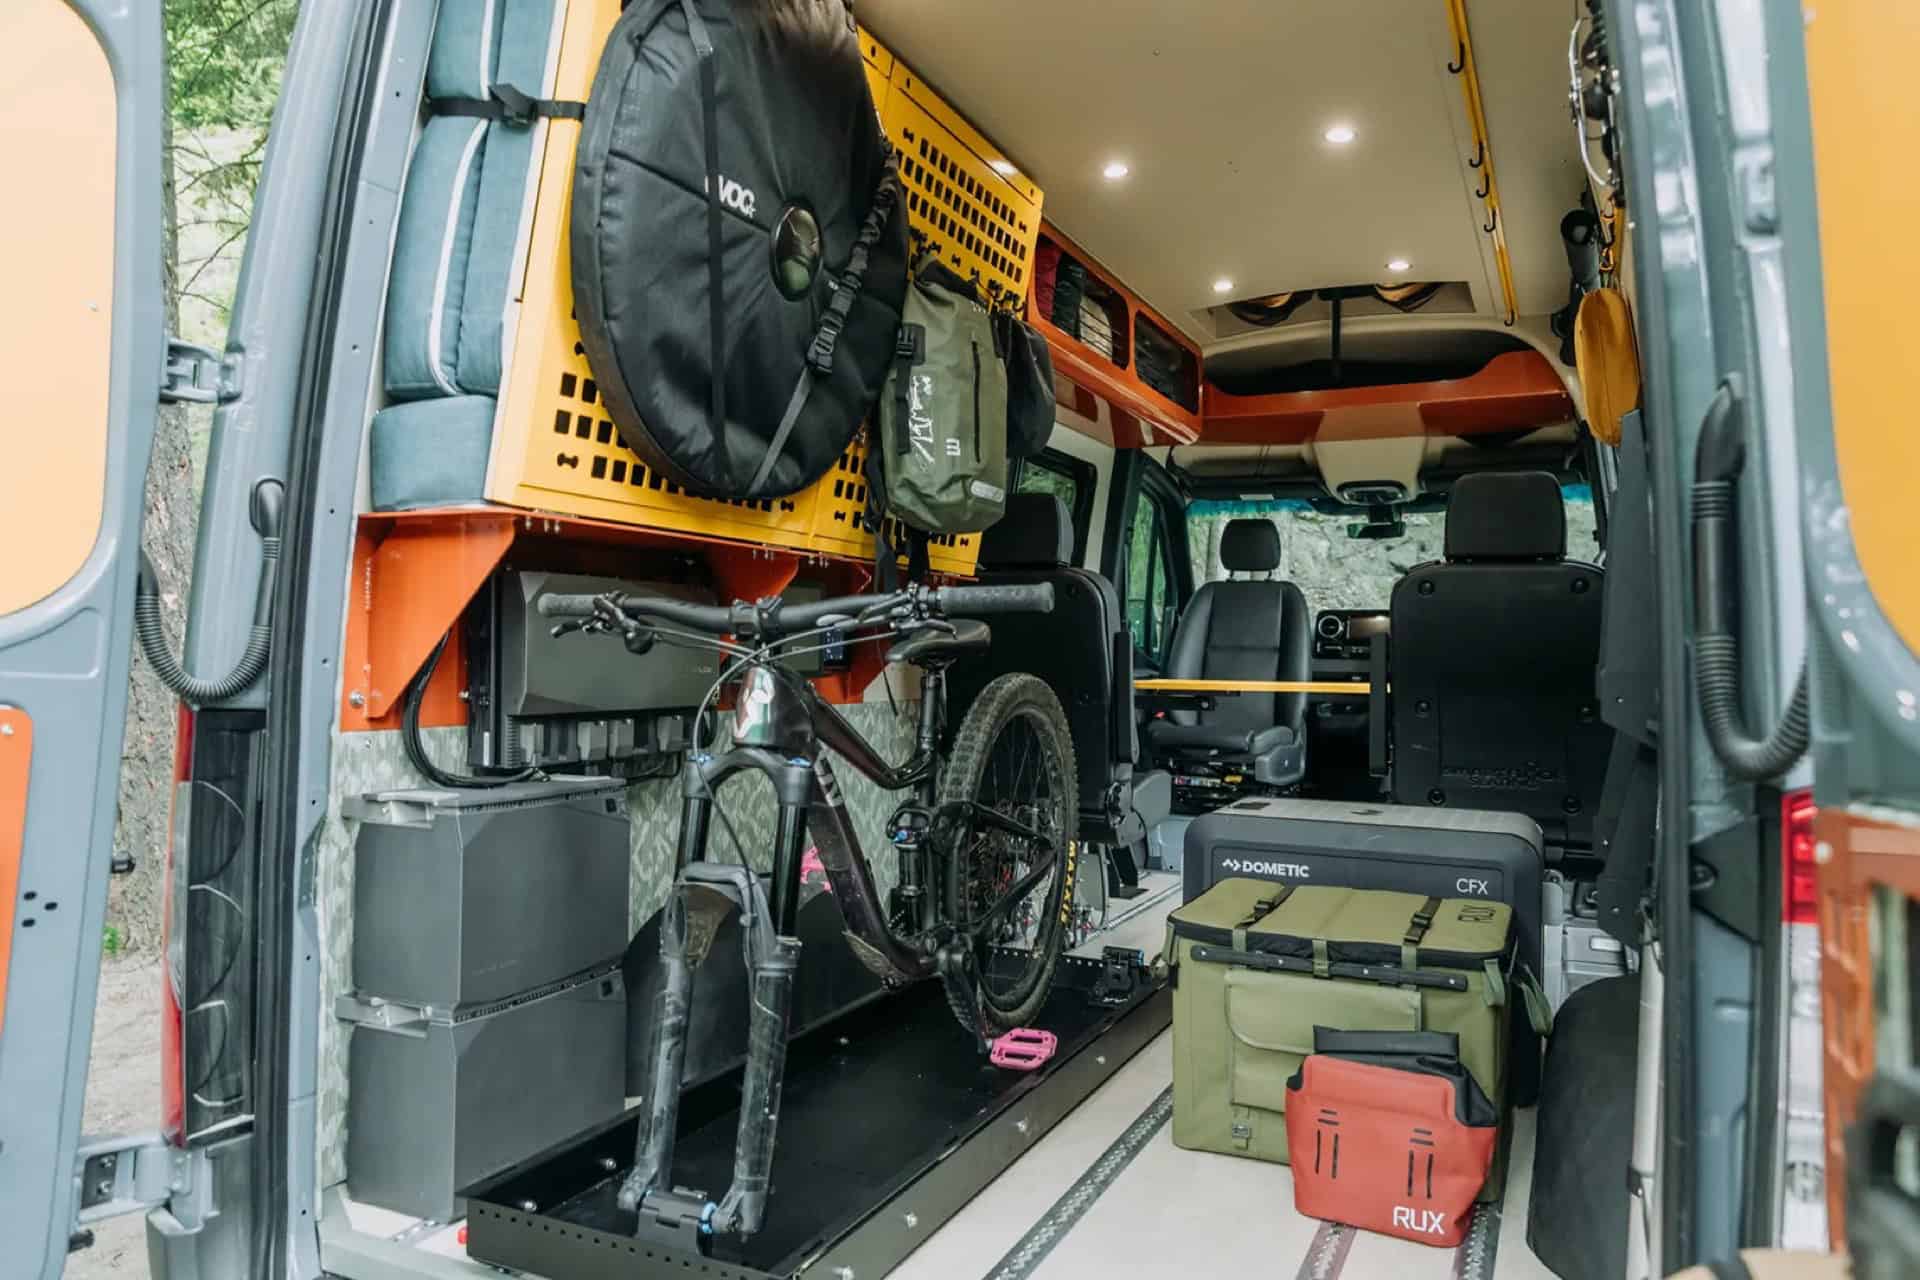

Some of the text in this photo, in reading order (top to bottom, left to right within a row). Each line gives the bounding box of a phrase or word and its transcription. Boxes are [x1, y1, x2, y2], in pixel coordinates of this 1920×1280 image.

[1242, 860, 1311, 878] DOMETIC
[1456, 878, 1489, 895] CFX
[1393, 1205, 1446, 1235] RUX
